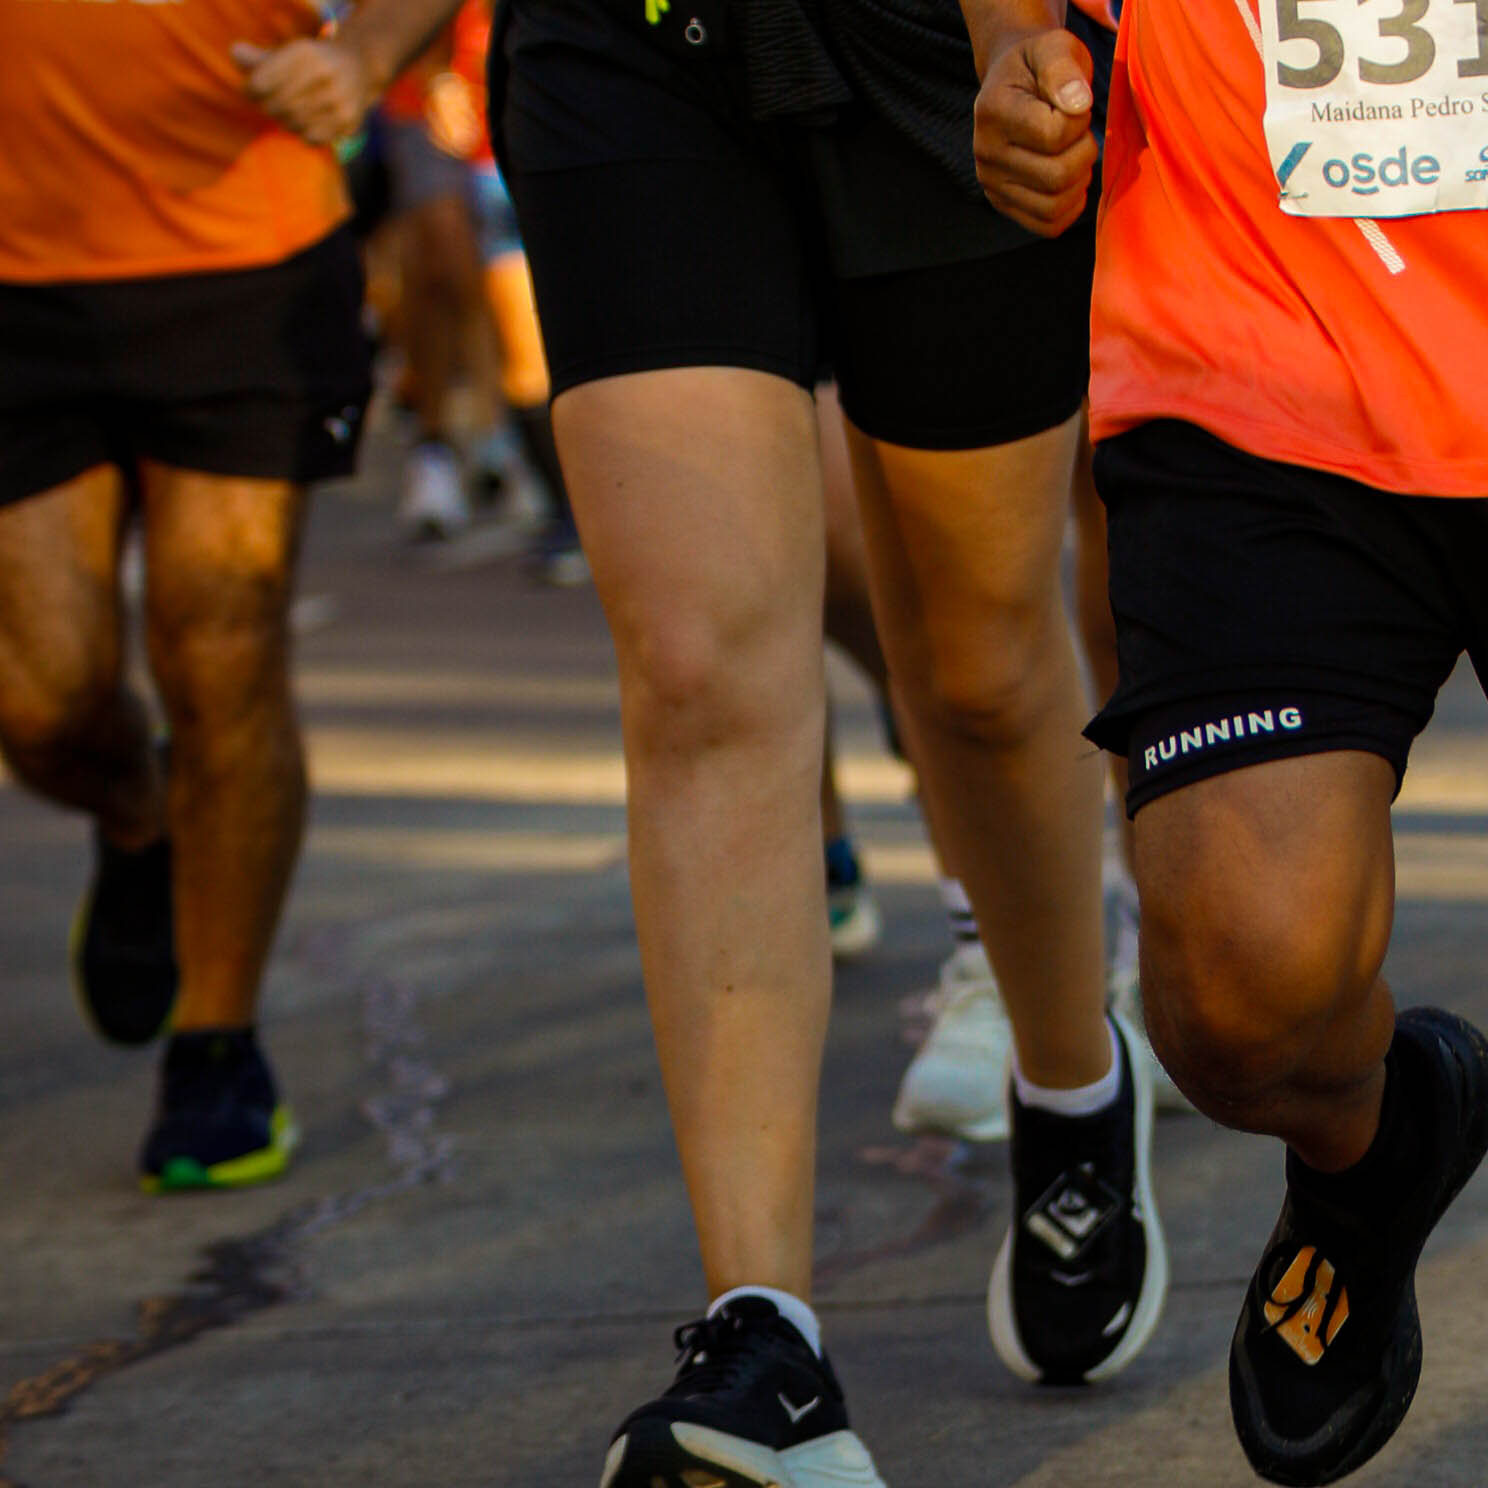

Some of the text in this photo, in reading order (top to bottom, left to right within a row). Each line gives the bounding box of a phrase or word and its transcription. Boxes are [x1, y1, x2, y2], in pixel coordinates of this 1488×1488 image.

[1311, 102, 1403, 123] Maidana
[1410, 96, 1474, 119] Pedro
[1322, 145, 1441, 195] osde
[1144, 707, 1302, 770] RUNNING
